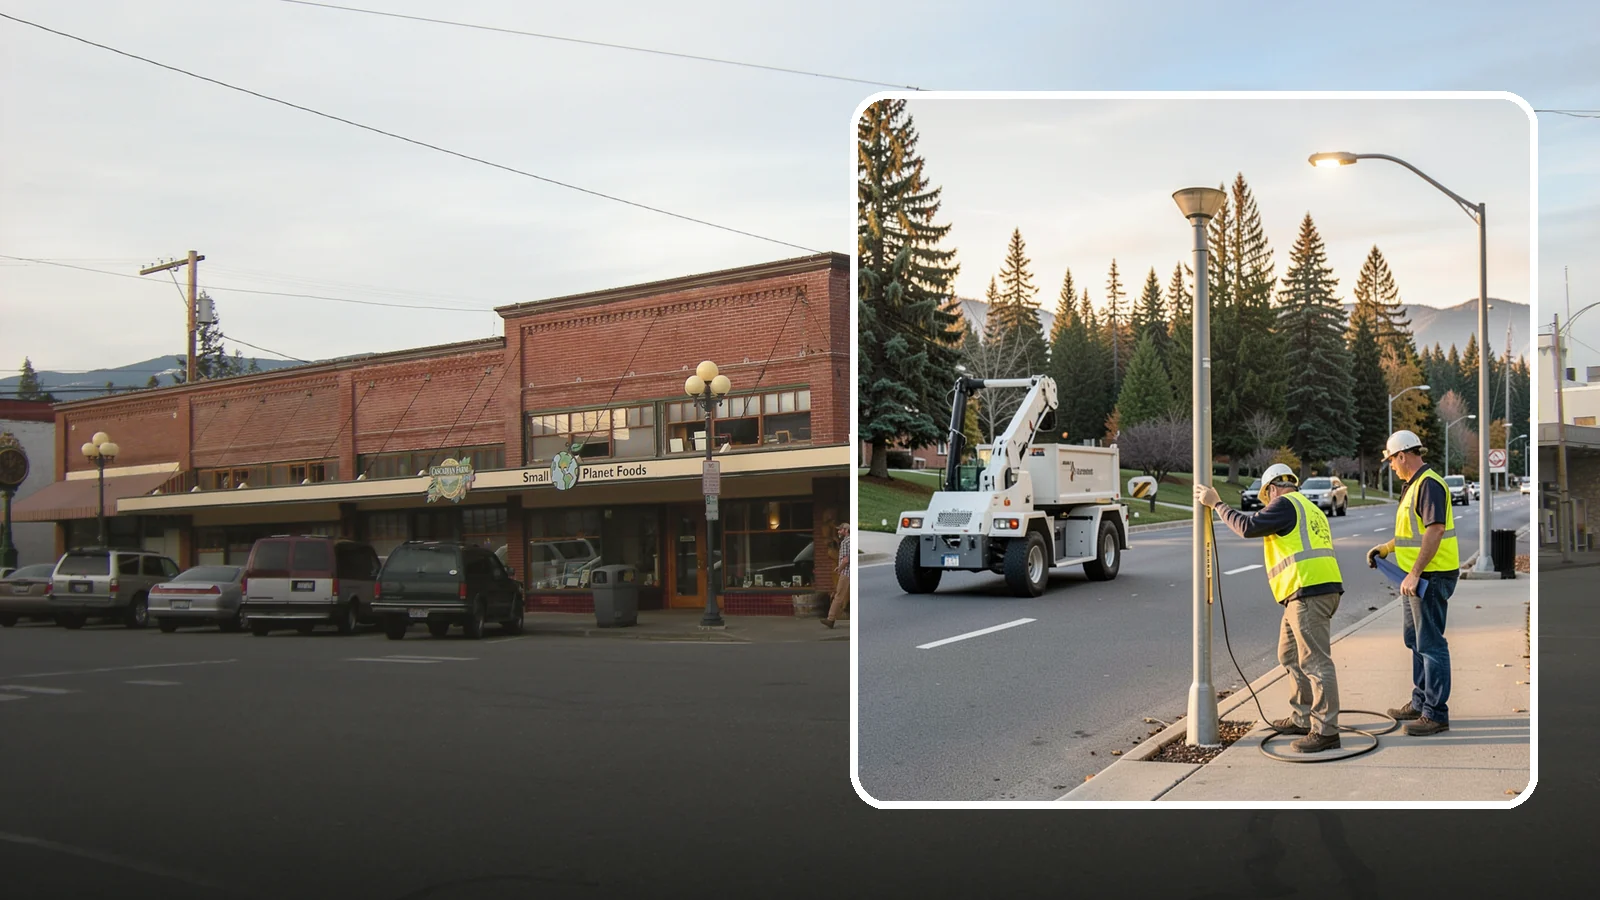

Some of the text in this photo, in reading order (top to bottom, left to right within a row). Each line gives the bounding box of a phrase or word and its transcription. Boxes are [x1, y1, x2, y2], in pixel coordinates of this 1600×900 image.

[523, 464, 647, 483] Small Planet Foods
